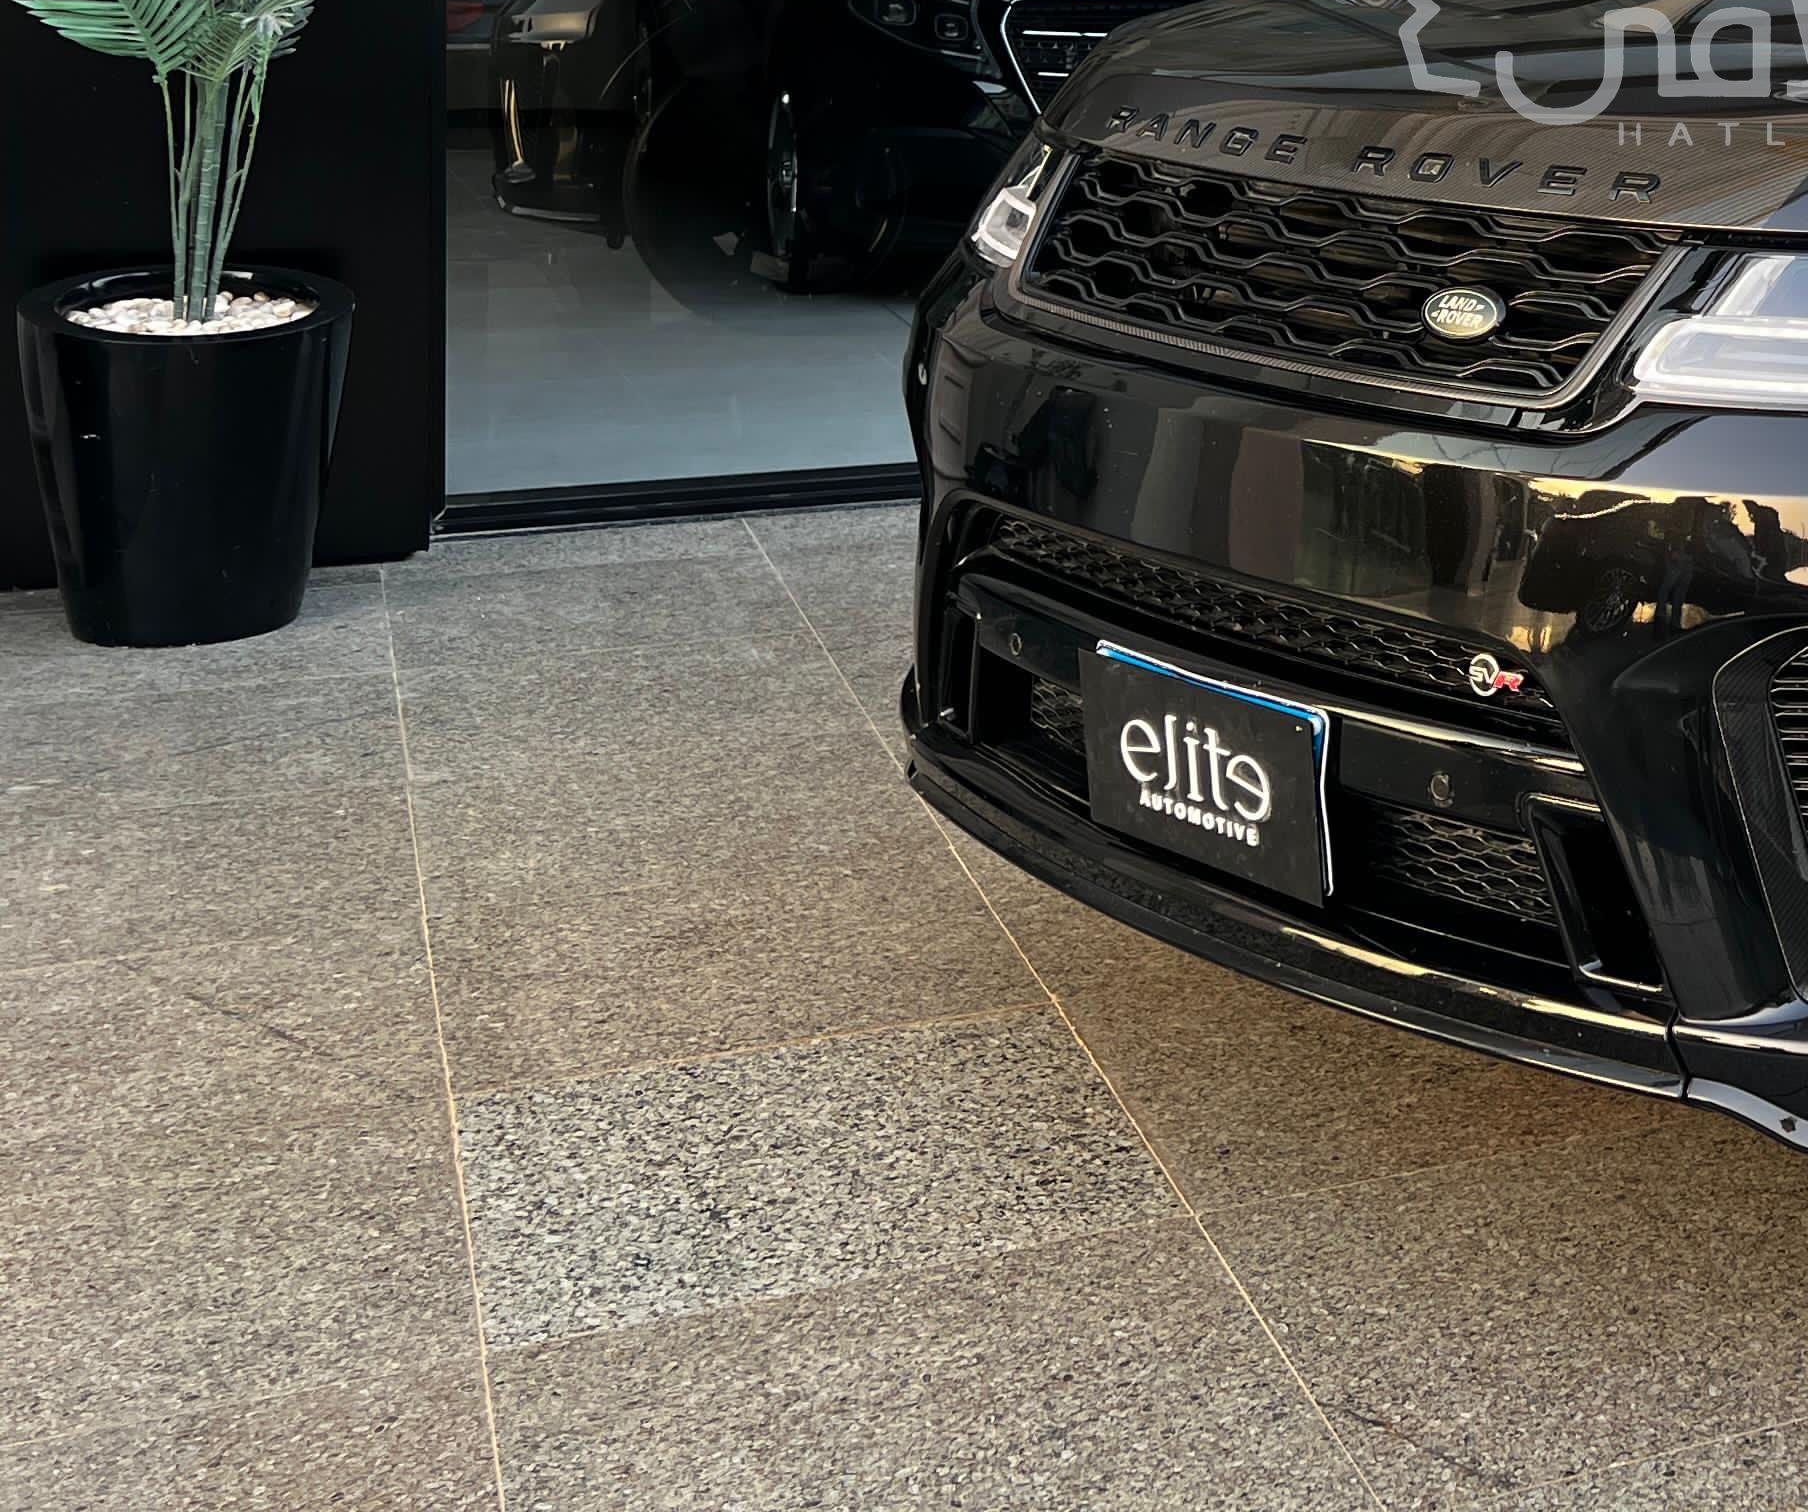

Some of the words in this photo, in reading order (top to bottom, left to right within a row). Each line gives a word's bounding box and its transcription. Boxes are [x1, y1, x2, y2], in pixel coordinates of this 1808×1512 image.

[1106, 104, 1307, 166] RANGE
[1349, 144, 1662, 205] ROVER
[1436, 308, 1484, 328] ROVER
[1438, 294, 1478, 312] LAND
[1468, 661, 1525, 693] SVR
[1139, 787, 1260, 847] AUTOMOTIVE
